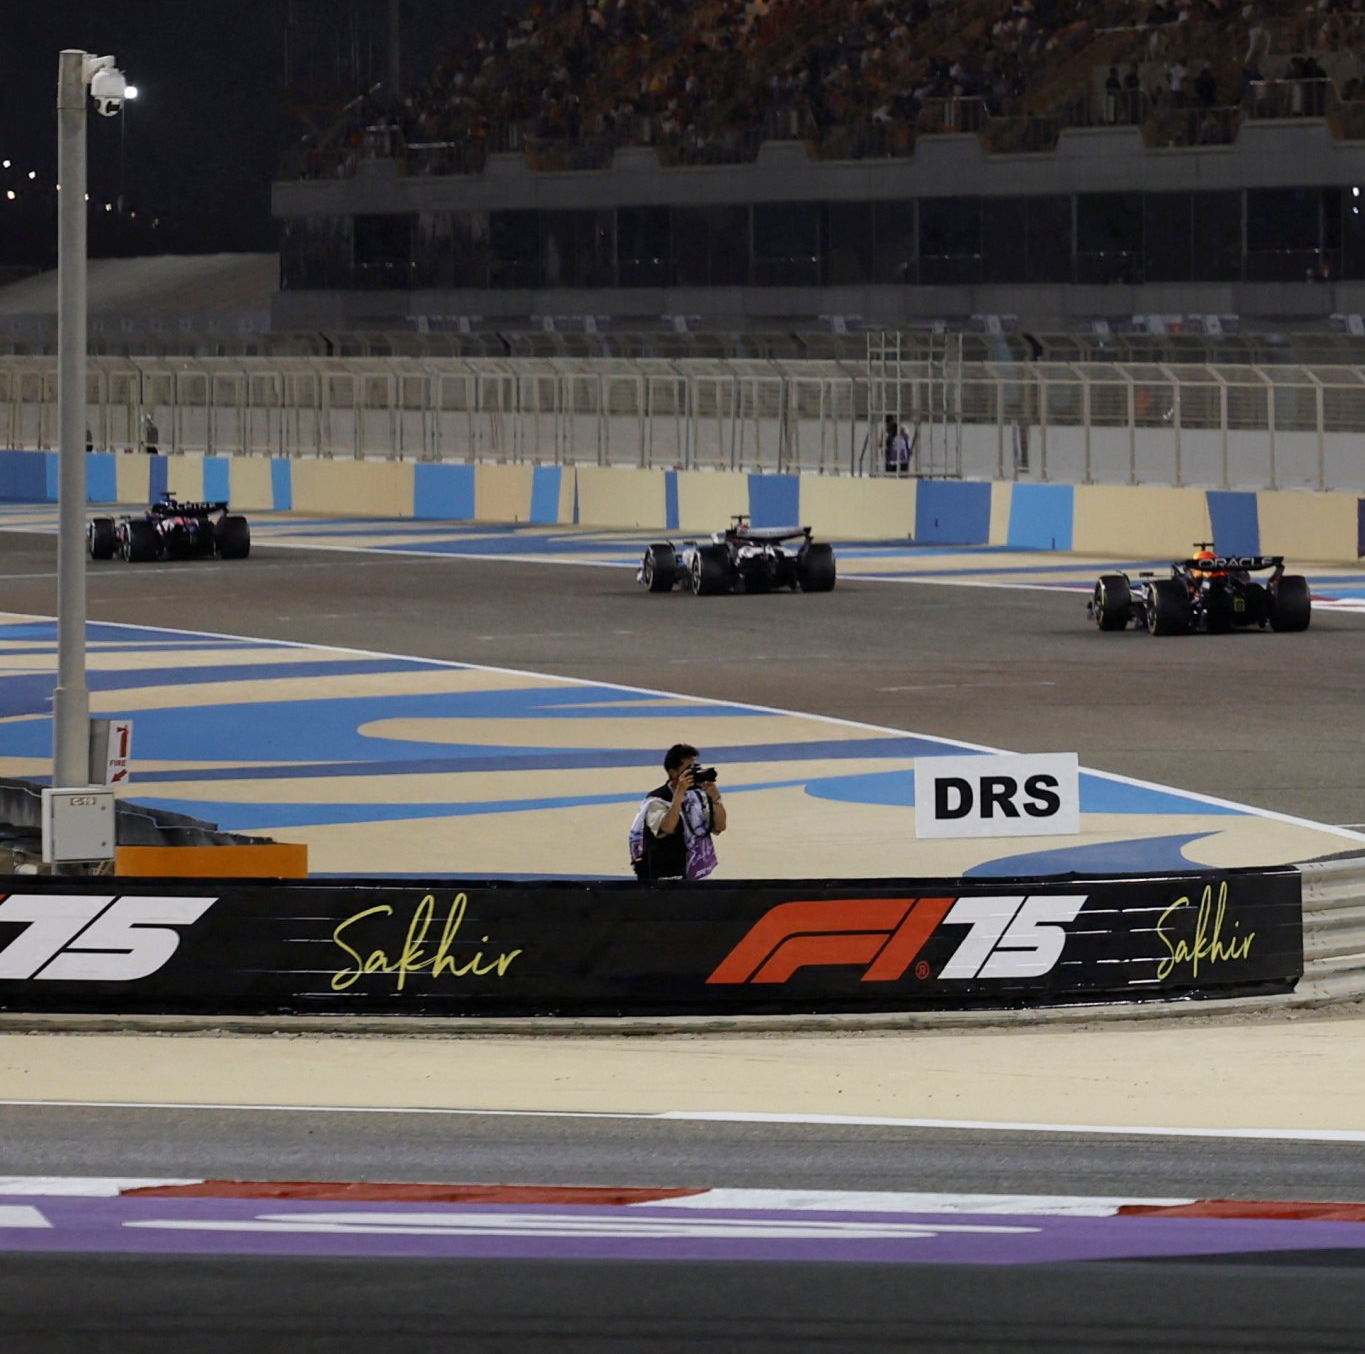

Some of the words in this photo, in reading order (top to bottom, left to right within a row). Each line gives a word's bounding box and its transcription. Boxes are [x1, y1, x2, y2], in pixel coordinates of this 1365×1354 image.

[1198, 557, 1274, 569] ORACLE
[109, 759, 127, 767] FIRE
[934, 774, 1061, 820] DRS
[0, 894, 219, 981] 75
[331, 892, 523, 991] Sakhir
[936, 895, 1089, 980] 75
[1157, 881, 1257, 981] Sakhir
